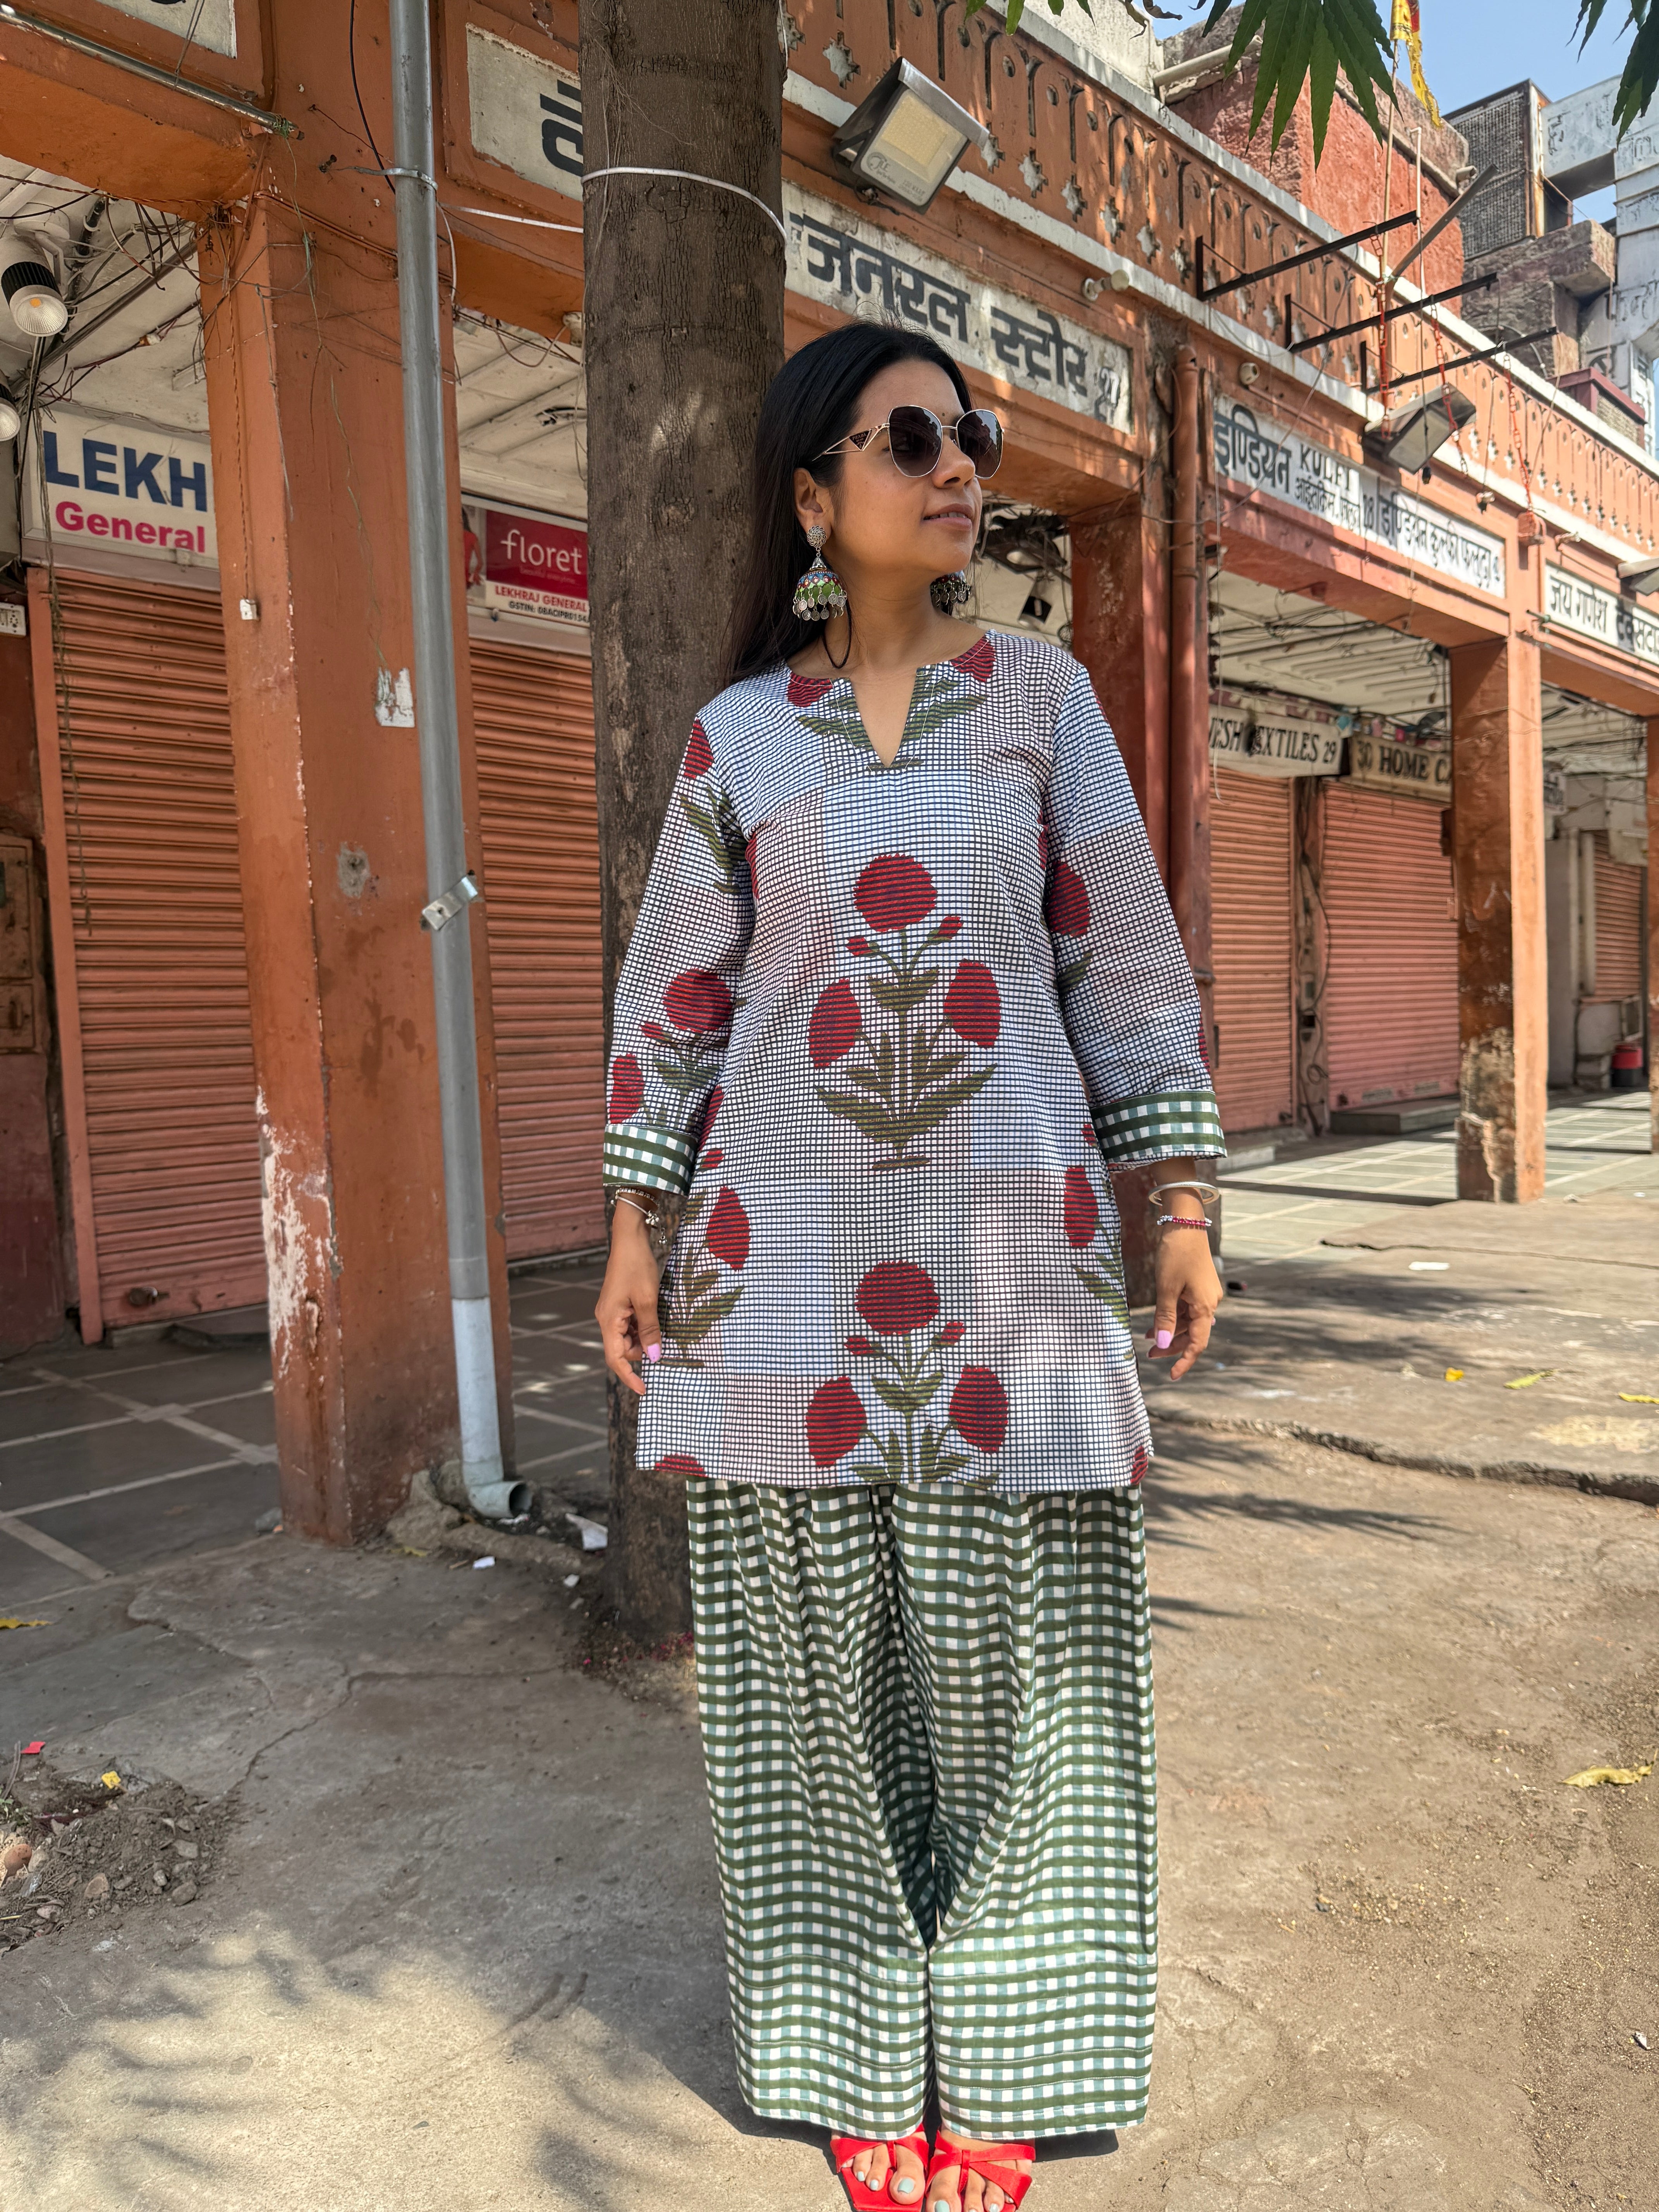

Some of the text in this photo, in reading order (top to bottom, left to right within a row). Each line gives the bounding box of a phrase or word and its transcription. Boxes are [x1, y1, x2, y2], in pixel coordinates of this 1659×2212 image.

[803, 213, 971, 343] जनरल
[991, 308, 1088, 398] स्टोर
[852, 432, 867, 441] PRADA
[43, 430, 208, 512] LEKH
[1300, 443, 1350, 491] KULFI
[55, 501, 206, 553] General
[500, 529, 582, 575] floret
[495, 584, 587, 613] LEKHRAJ GENERAL
[1549, 574, 1573, 620] जय
[1322, 740, 1336, 764] 29
[1379, 745, 1430, 782] HOME
